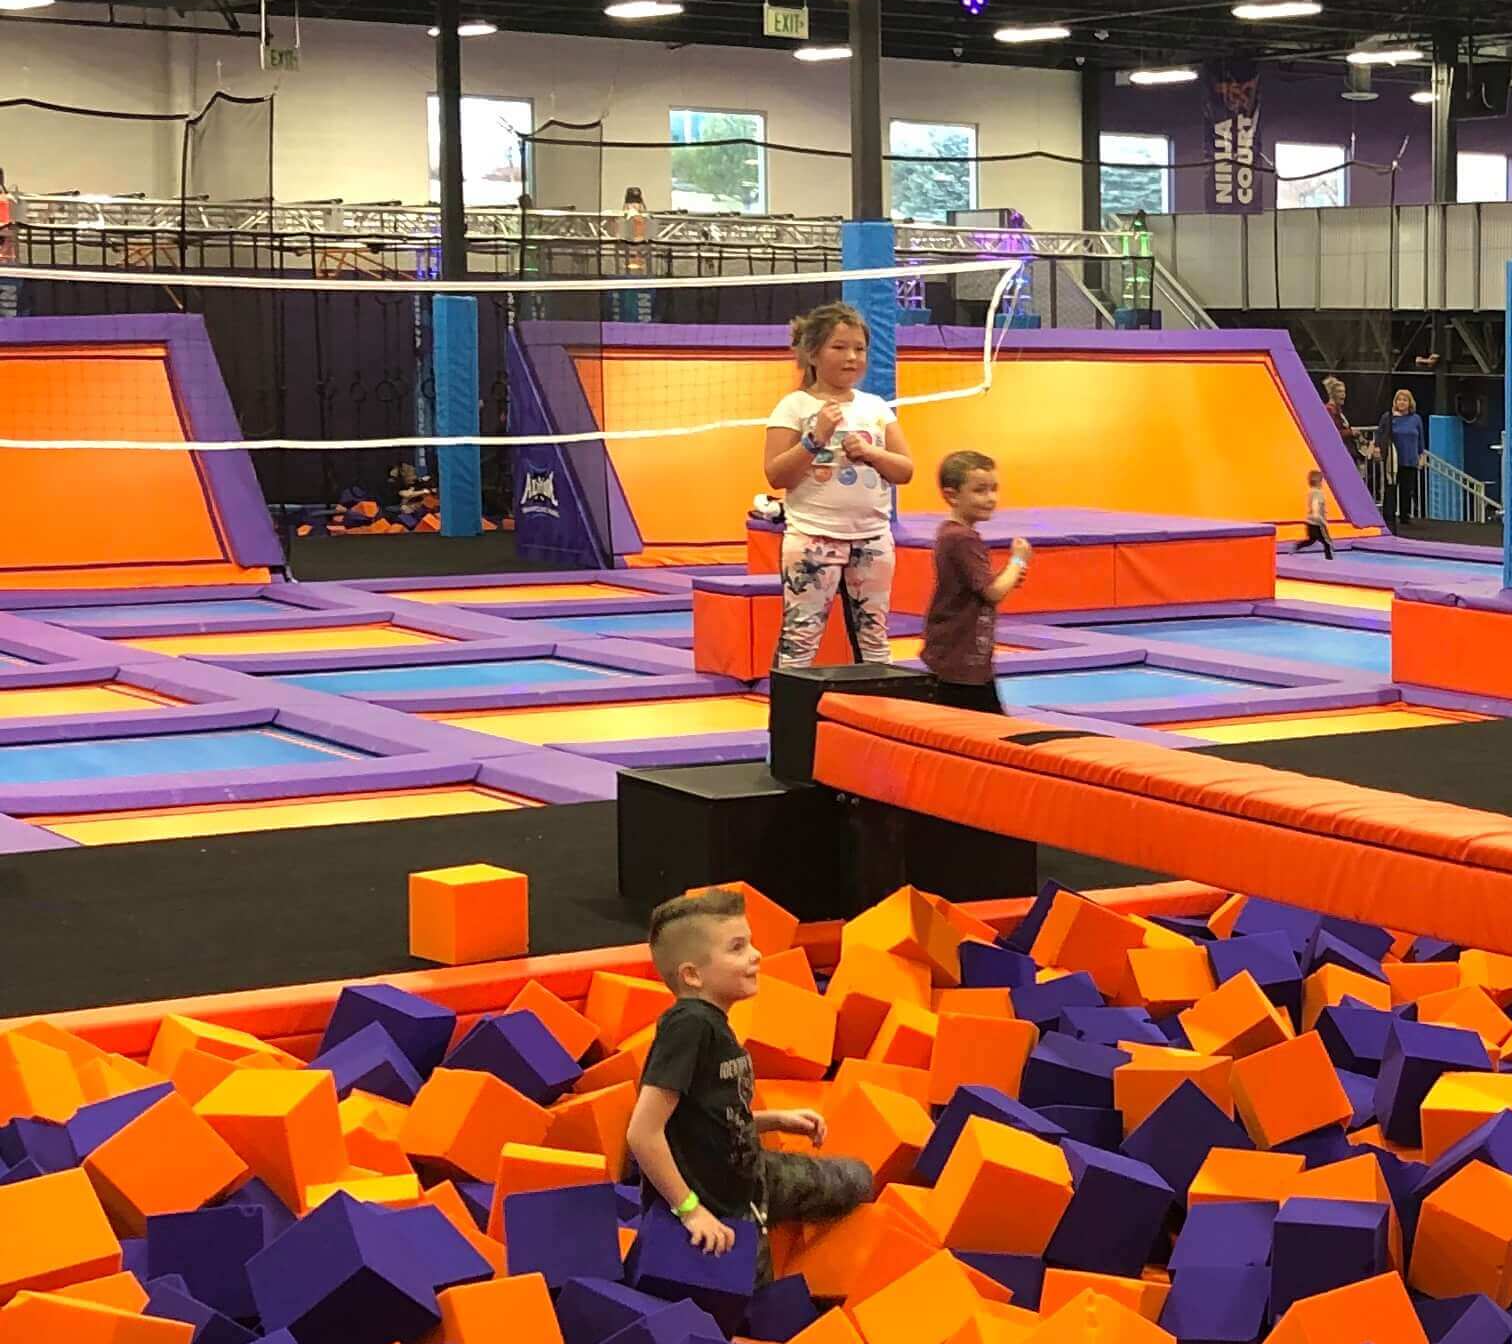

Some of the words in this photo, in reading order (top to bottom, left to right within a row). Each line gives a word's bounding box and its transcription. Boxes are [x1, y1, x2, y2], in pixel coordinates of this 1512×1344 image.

[775, 12, 801, 33] EXIT
[1214, 118, 1233, 204] NINJA
[1237, 113, 1254, 205] COURT
